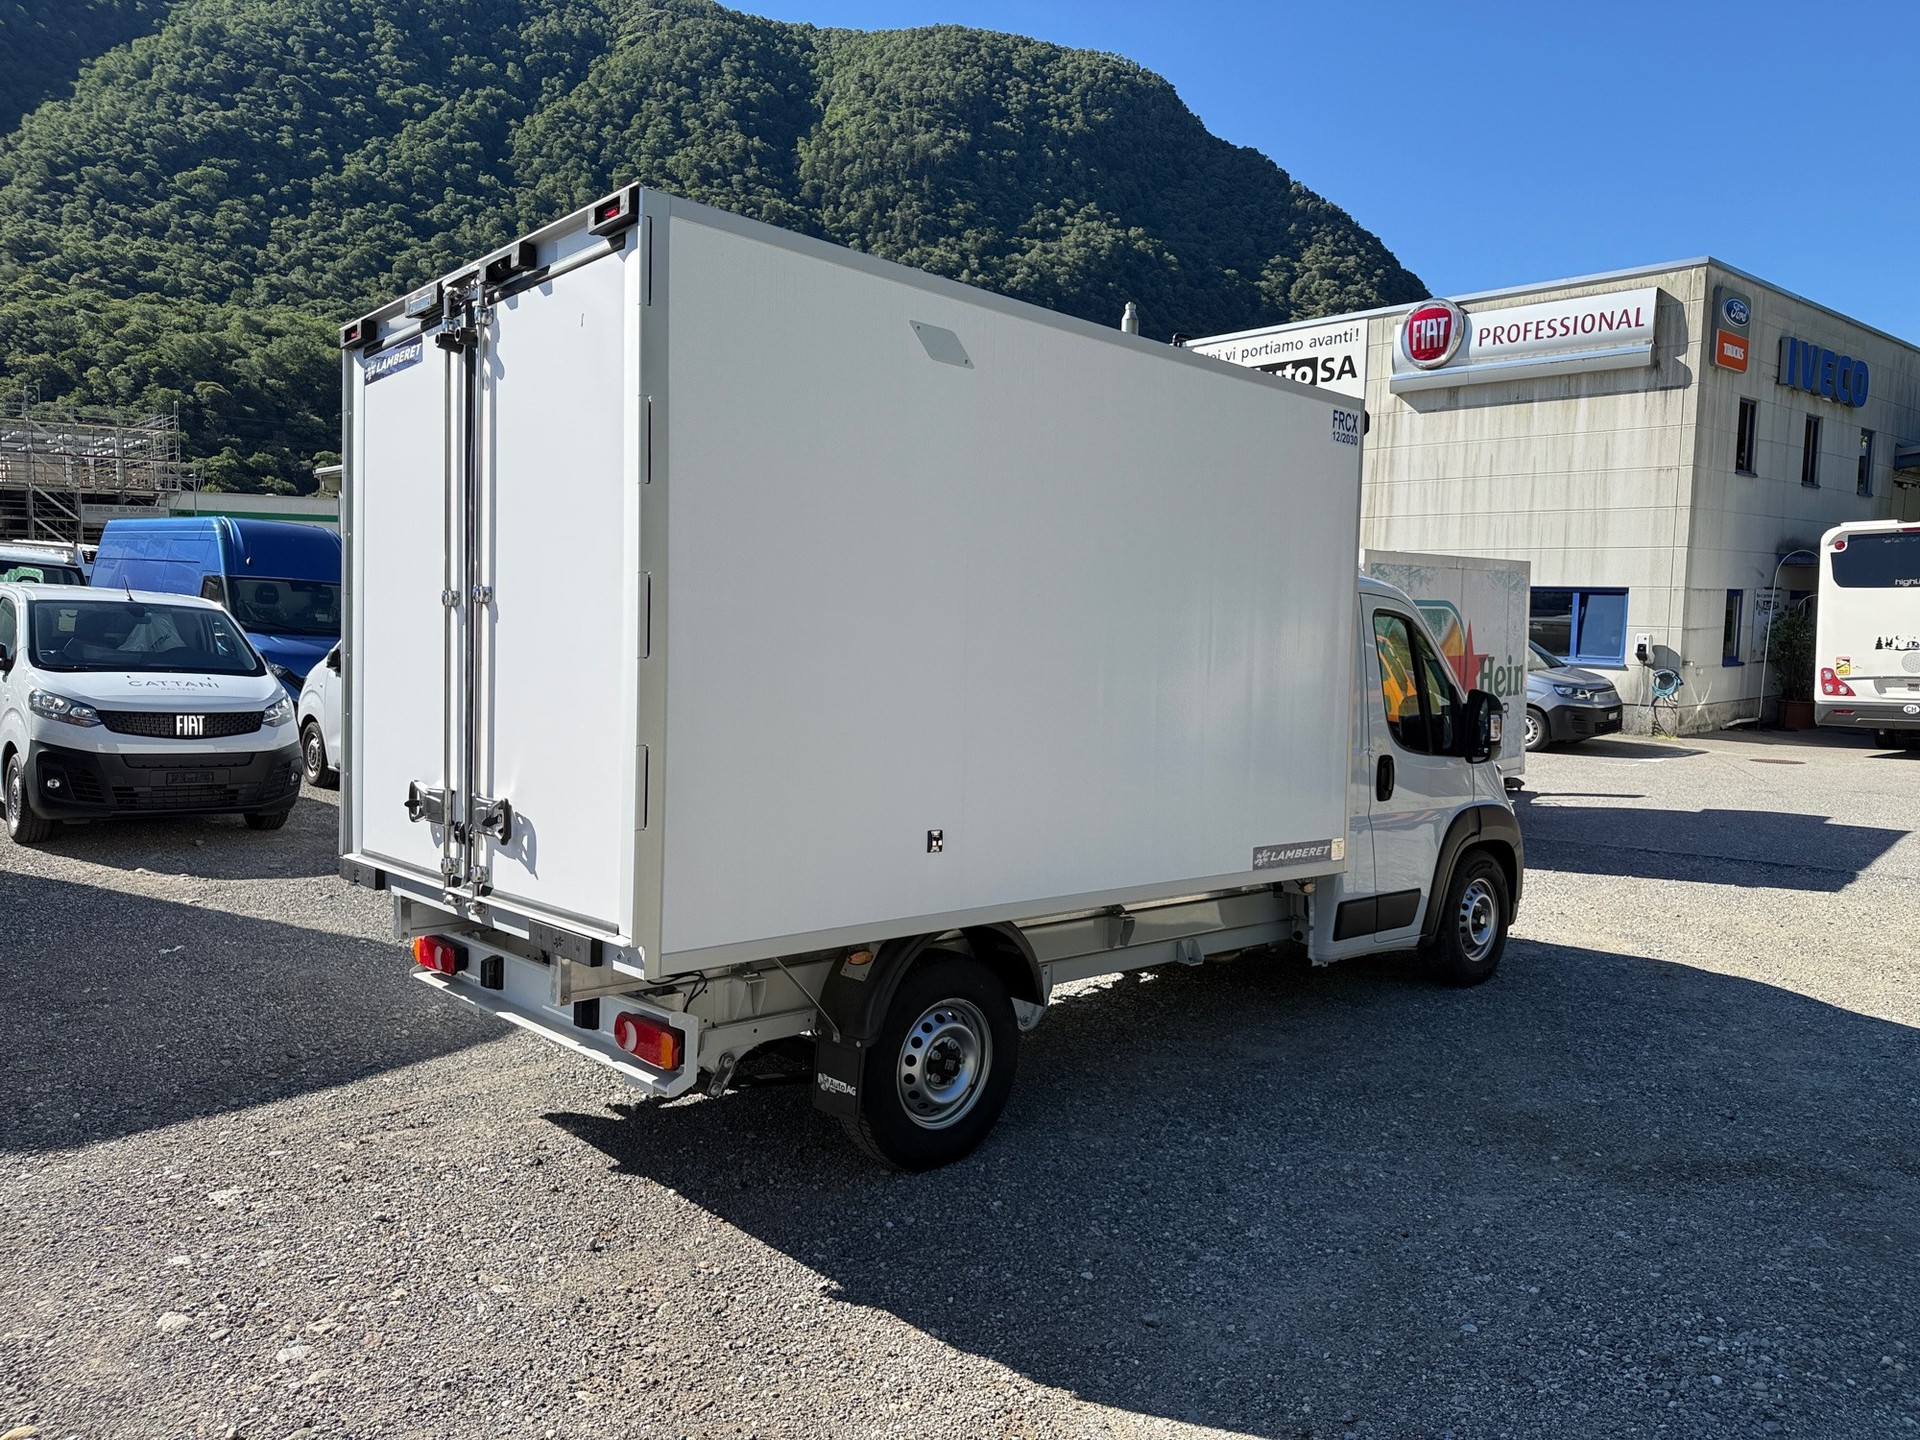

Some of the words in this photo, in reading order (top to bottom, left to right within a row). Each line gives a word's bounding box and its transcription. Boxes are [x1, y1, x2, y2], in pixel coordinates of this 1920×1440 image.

[1730, 301, 1748, 322] Ford
[1412, 316, 1449, 351] FIAT
[1478, 306, 1645, 347] PROFESSIONAL
[1225, 346, 1236, 361] vi
[1241, 339, 1304, 362] portiamo
[1309, 327, 1359, 349] avanti!
[376, 343, 422, 373] LAMBERET
[1783, 336, 1869, 408] IVECO
[1332, 409, 1358, 434] FRCX
[1332, 431, 1359, 446] 12/2030
[128, 680, 219, 689] CATTANI
[1479, 654, 1523, 698] Hein
[176, 714, 205, 736] FIAT
[1270, 845, 1331, 861] LAMBERET
